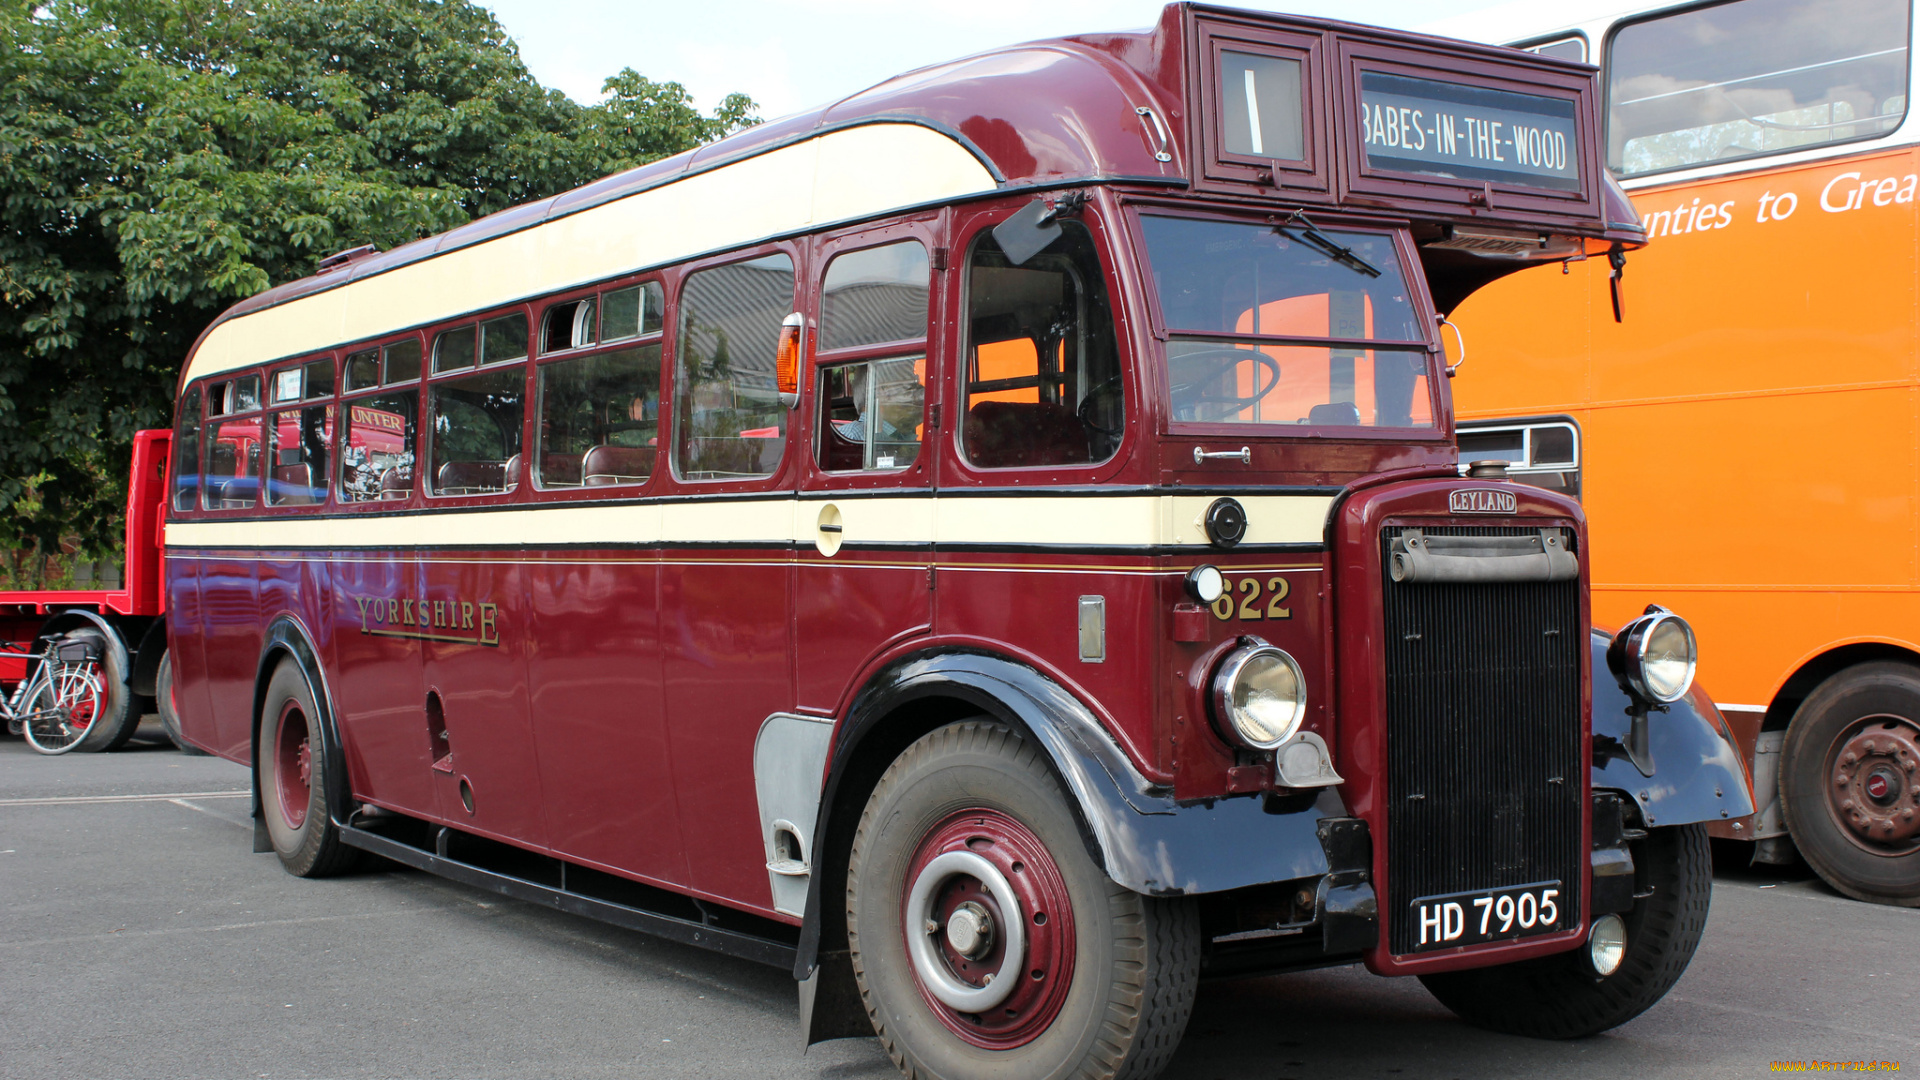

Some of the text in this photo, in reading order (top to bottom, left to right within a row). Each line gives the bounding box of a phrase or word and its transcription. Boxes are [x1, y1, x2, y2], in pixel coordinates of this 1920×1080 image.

[1756, 190, 1798, 223] to
[1819, 171, 1919, 213] Grea
[351, 408, 403, 432] UNTER
[1452, 491, 1516, 512] LEYLAND
[355, 597, 499, 646] YORKSHIRE
[1211, 576, 1292, 621] 622
[1419, 888, 1560, 944] HD 7905
